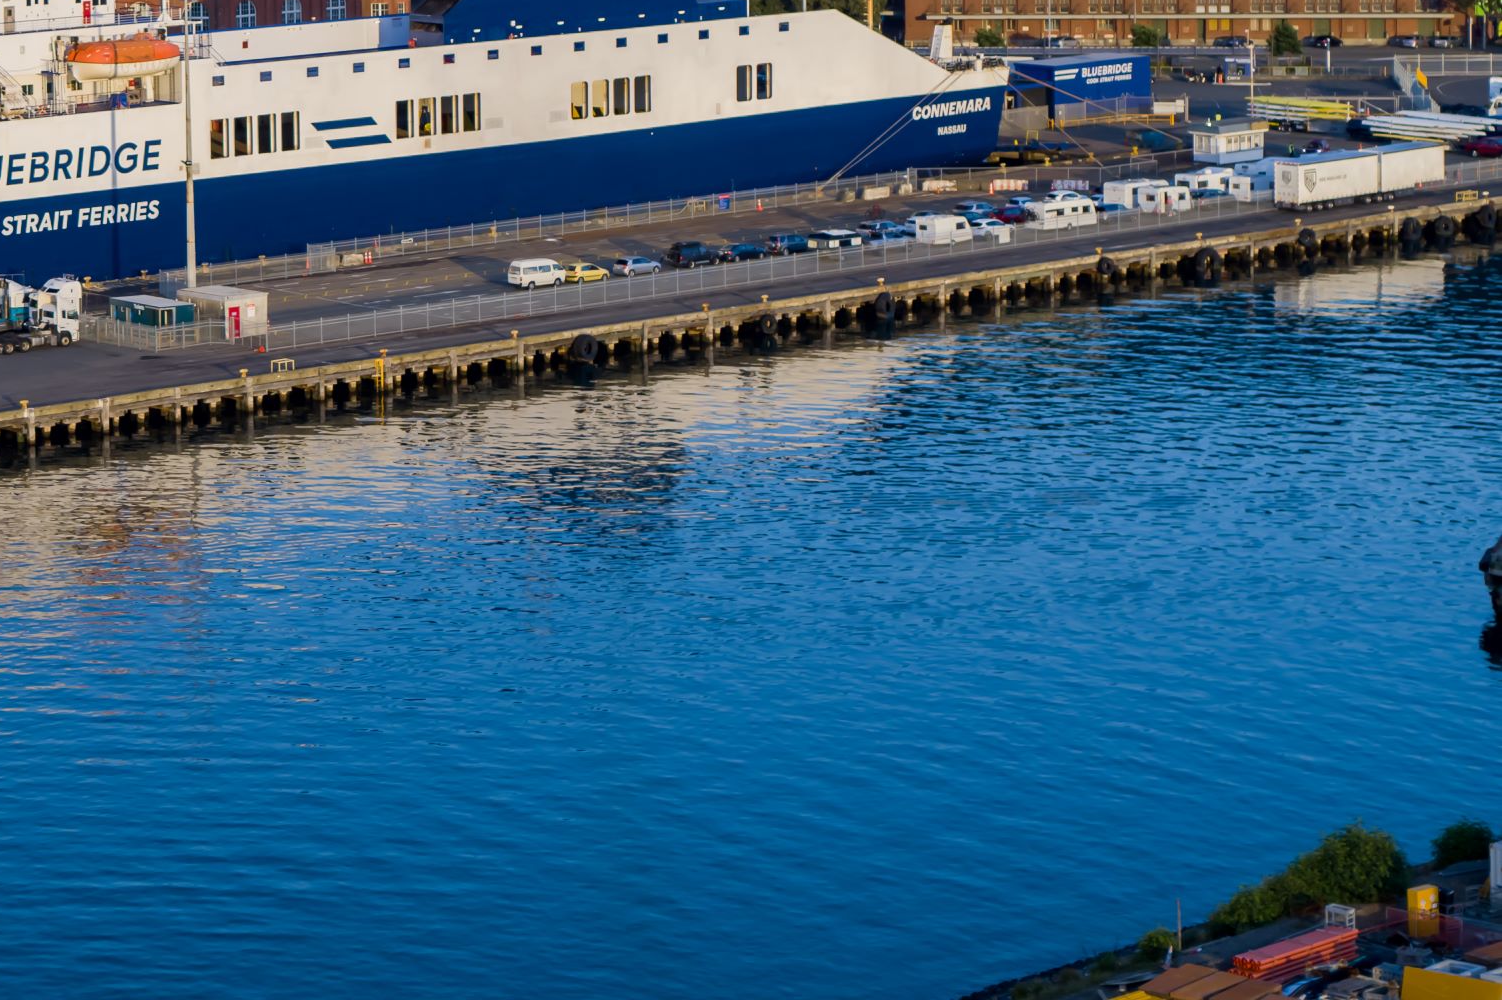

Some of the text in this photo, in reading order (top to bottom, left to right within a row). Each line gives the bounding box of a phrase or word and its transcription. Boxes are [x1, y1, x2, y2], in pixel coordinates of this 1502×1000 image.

[1081, 62, 1133, 78] BLUEBRIDGE
[912, 97, 991, 121] CONNEMARA
[937, 124, 967, 136] NASSAU
[1, 210, 72, 236] STRAIT
[77, 200, 160, 228] FERRIES
